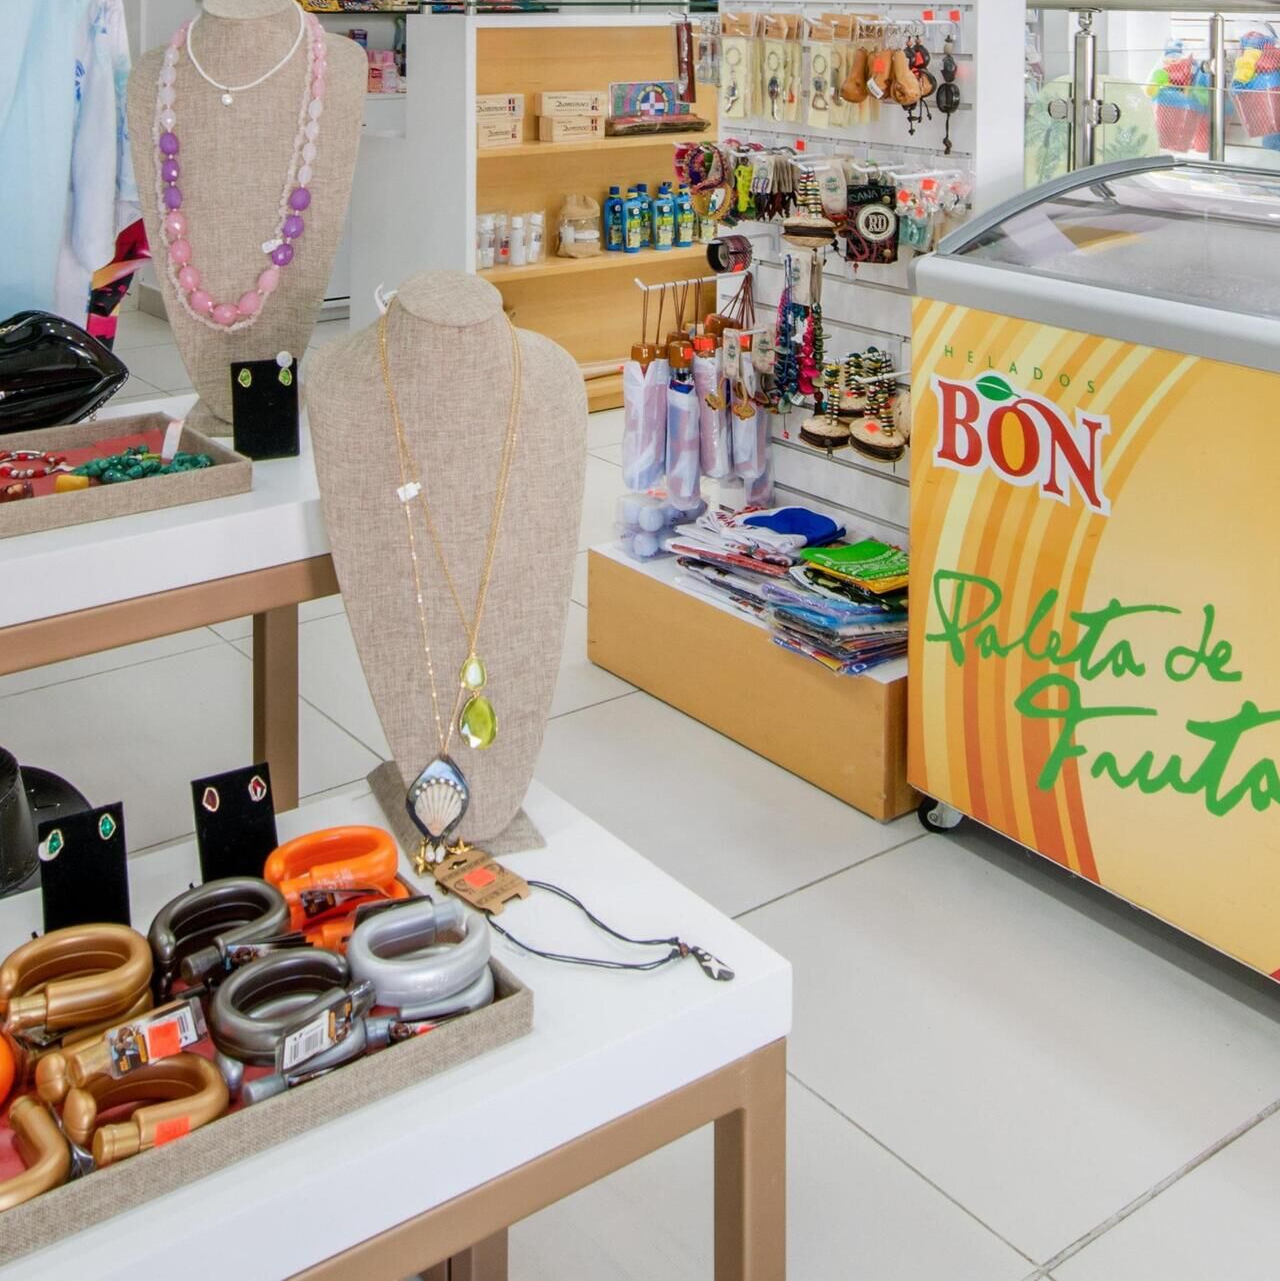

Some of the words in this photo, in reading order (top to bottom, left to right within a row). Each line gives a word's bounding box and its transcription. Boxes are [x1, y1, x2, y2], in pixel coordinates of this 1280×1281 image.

[868, 214, 888, 232] RD
[944, 344, 1096, 395] HELADOS
[937, 379, 1103, 510] BON
[924, 568, 1184, 682] Paleta
[1164, 603, 1243, 683] de
